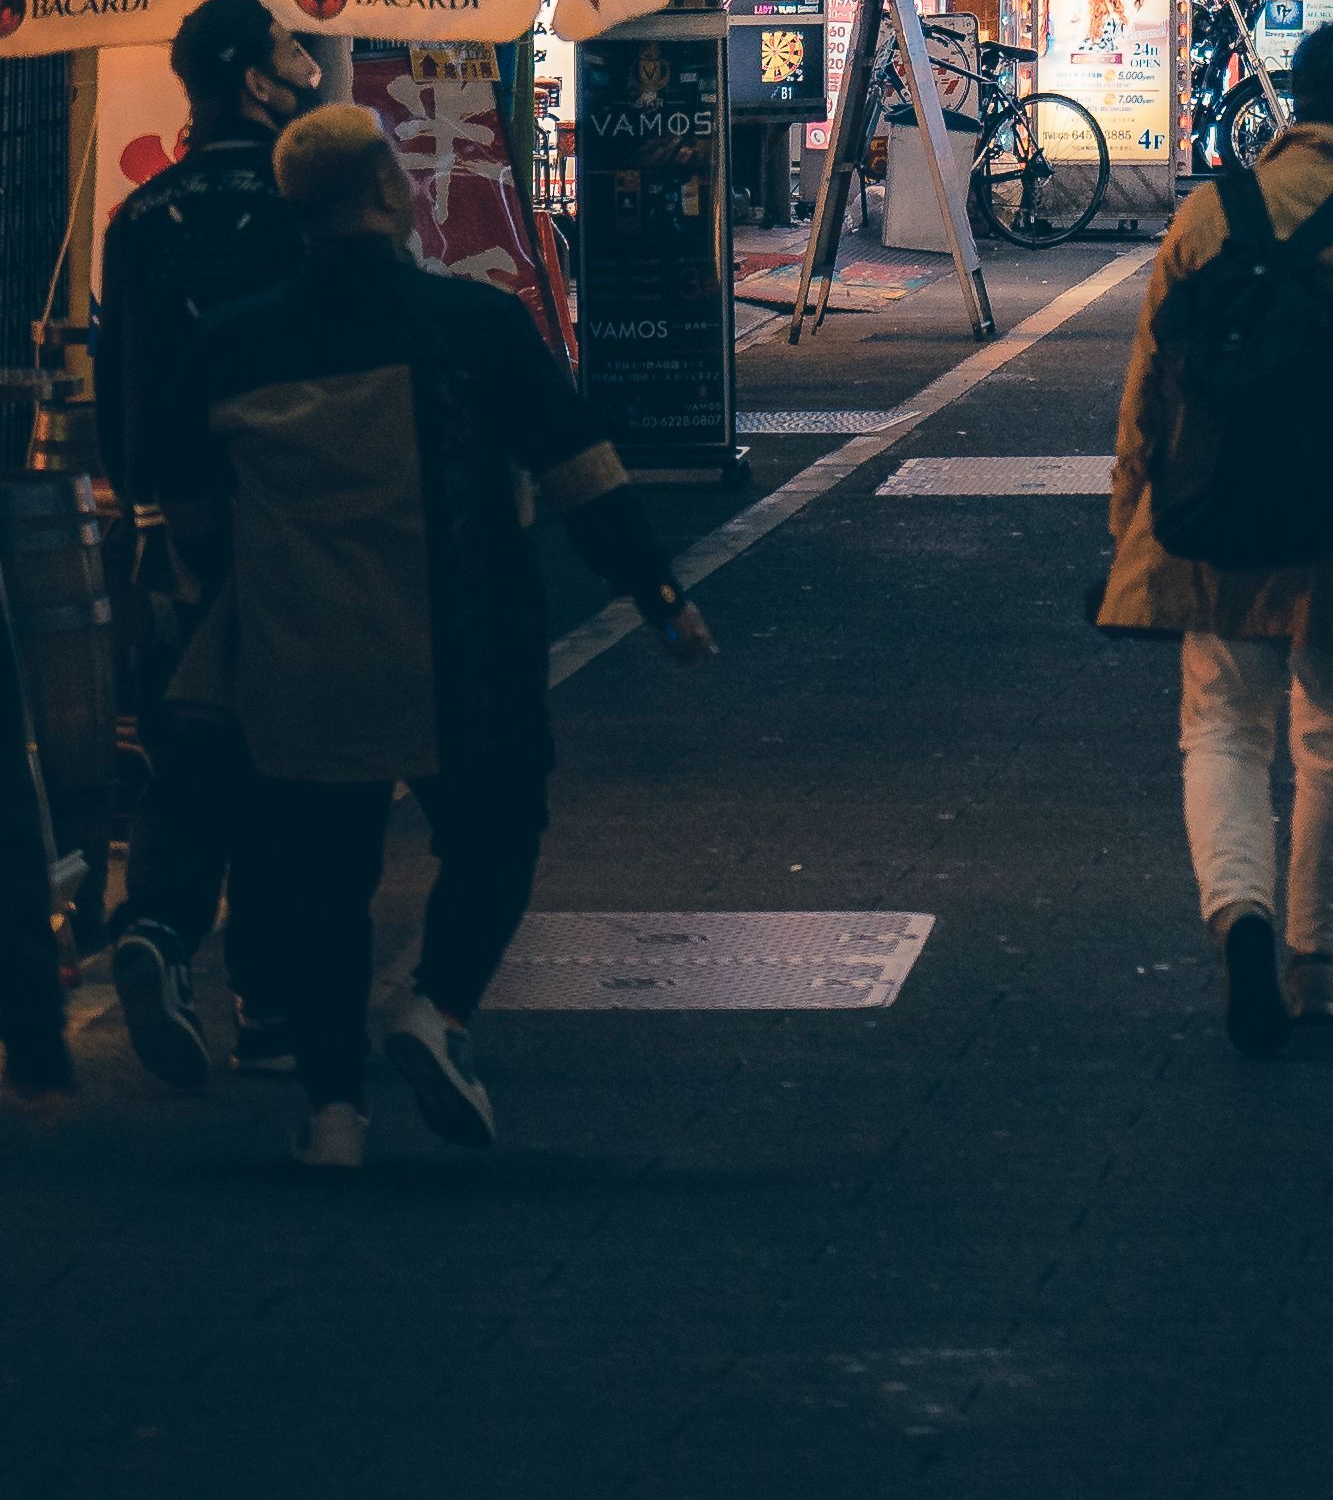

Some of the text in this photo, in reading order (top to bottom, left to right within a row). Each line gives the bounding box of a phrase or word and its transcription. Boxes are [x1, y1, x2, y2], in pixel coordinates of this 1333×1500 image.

[1130, 57, 1162, 70] OPEN
[590, 110, 714, 138] VAMOS
[1138, 126, 1167, 152] 4F
[590, 320, 670, 340] VAMOS
